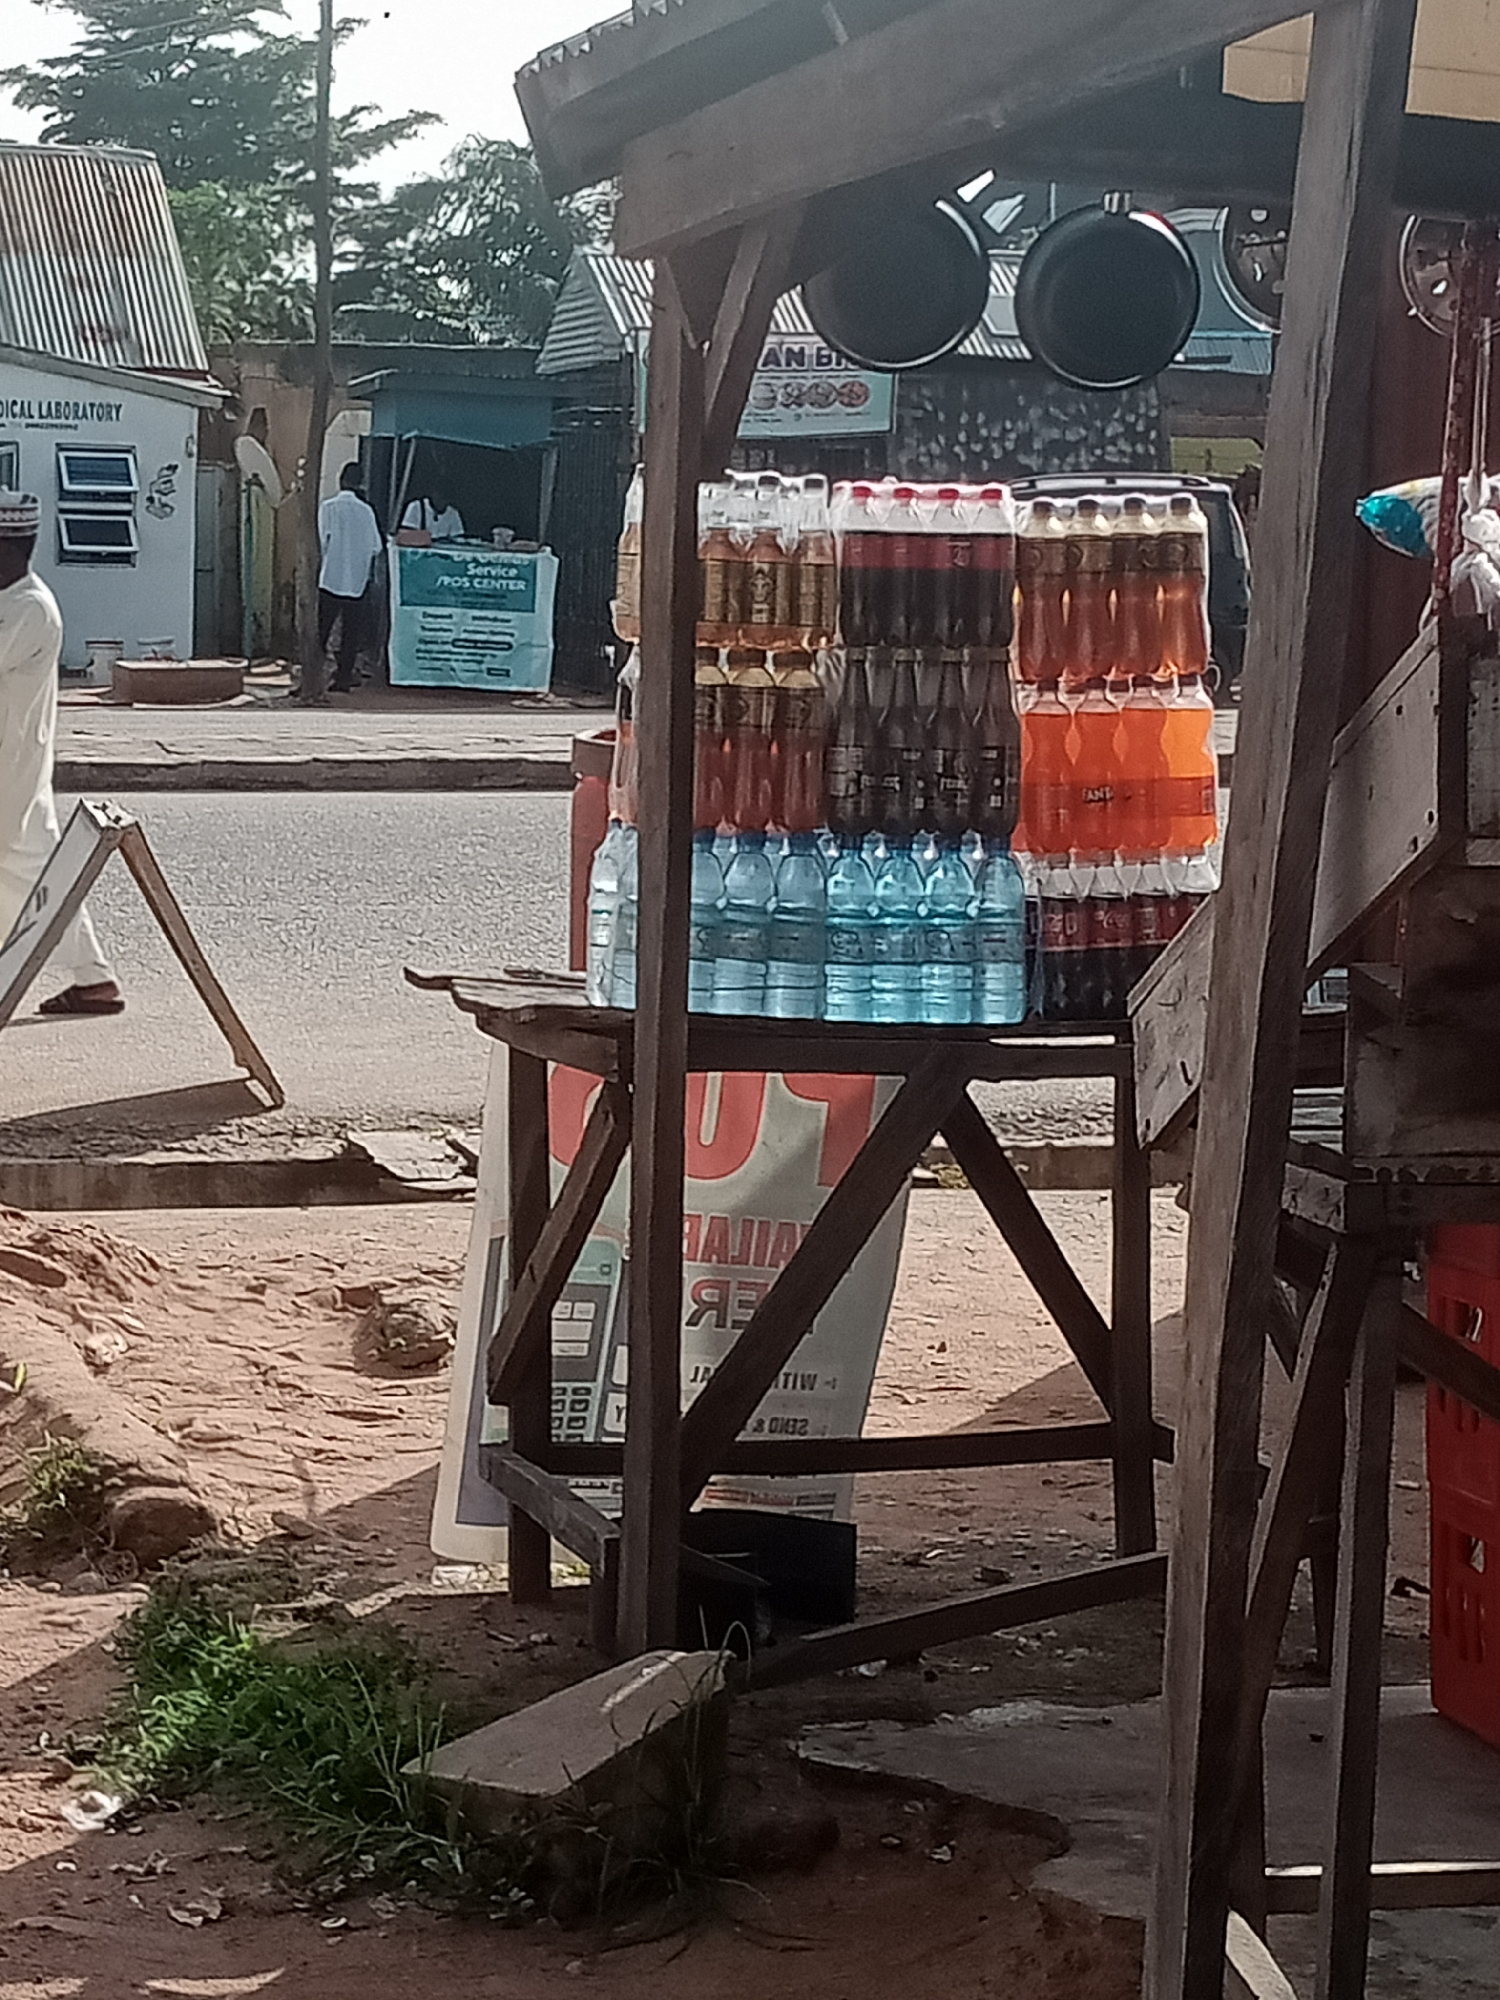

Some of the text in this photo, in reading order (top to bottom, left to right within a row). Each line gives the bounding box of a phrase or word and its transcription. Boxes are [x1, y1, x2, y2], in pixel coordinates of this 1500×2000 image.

[38, 400, 122, 422] LABORATORY
[466, 563, 518, 578] Service
[472, 577, 527, 591] CENTER
